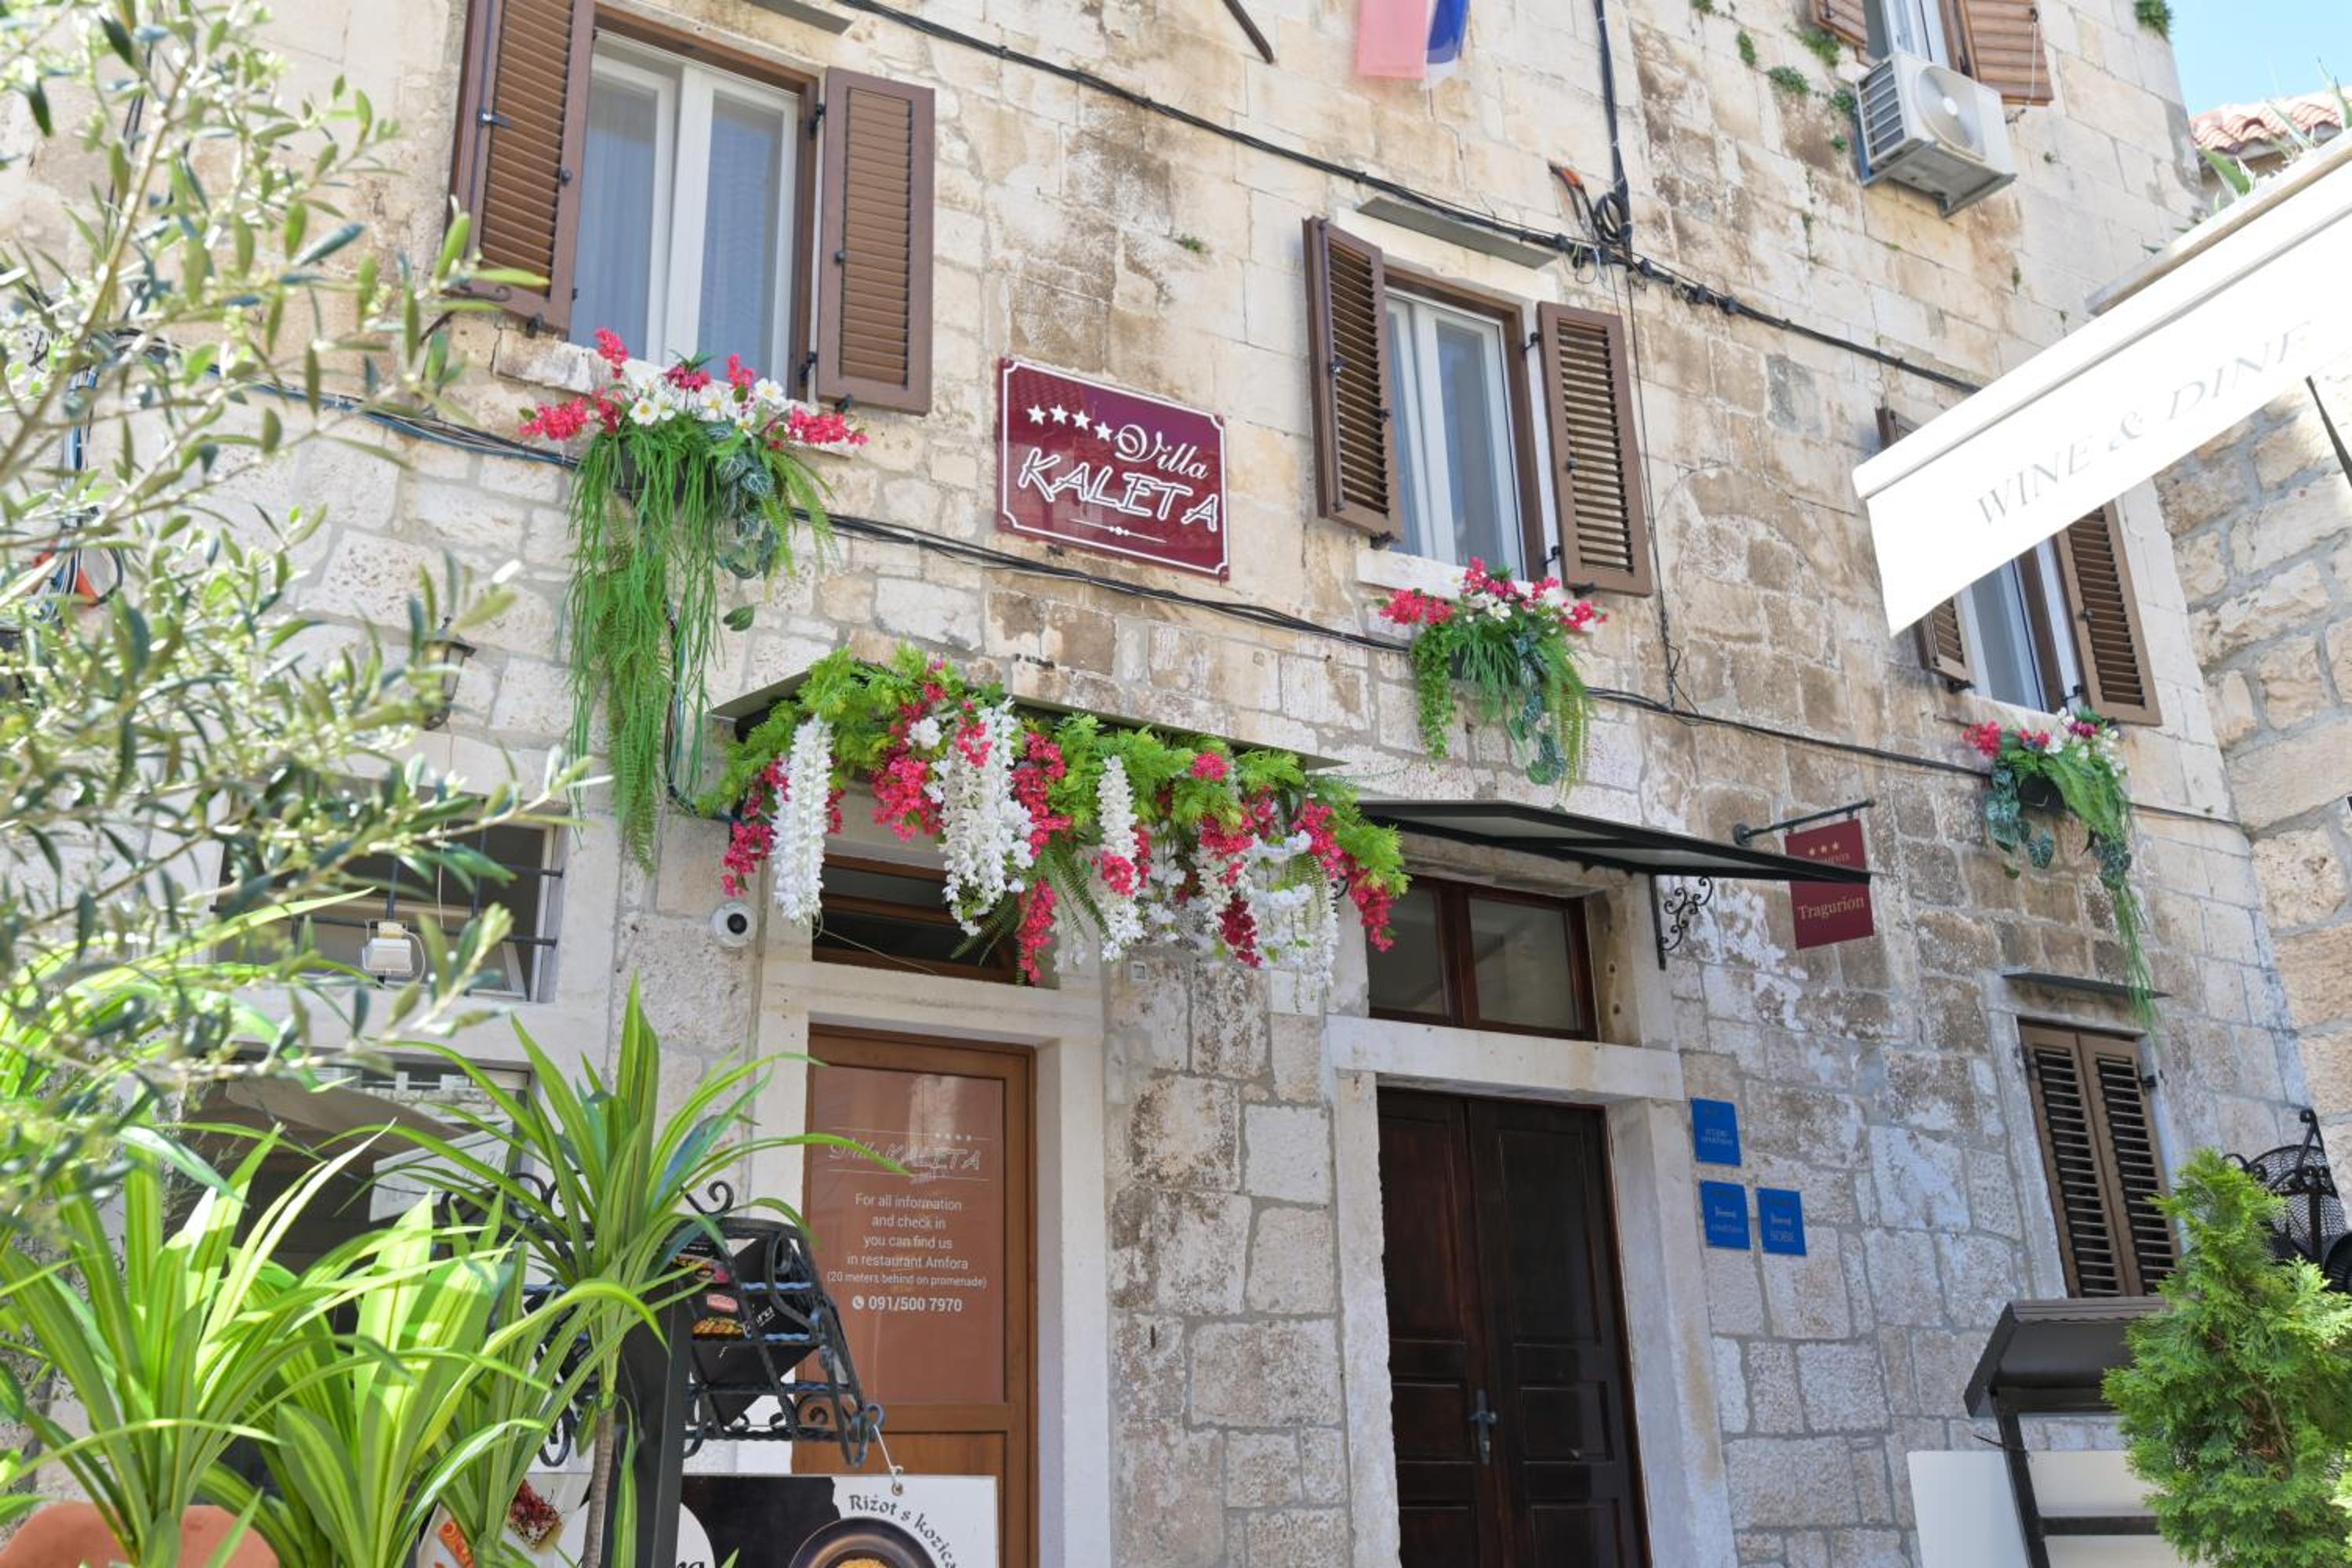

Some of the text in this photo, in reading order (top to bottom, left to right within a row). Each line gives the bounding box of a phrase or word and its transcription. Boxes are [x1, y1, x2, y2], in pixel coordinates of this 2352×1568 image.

[1114, 424, 1209, 480] Villa
[1976, 434, 2093, 525] WINE
[1017, 447, 1218, 532] KALETA
[1797, 896, 1865, 920] Tragurion
[855, 1193, 962, 1211] For all information
[872, 1216, 946, 1230] and check in
[864, 1236, 953, 1249] you can find us
[847, 1254, 968, 1269] in restaurant Amfora
[845, 1272, 879, 1283] meters
[882, 1273, 913, 1285] behind
[916, 1276, 928, 1285] on
[931, 1275, 987, 1288] promenade)
[869, 1296, 963, 1312] 091/500 7970
[901, 1511, 911, 1522] s
